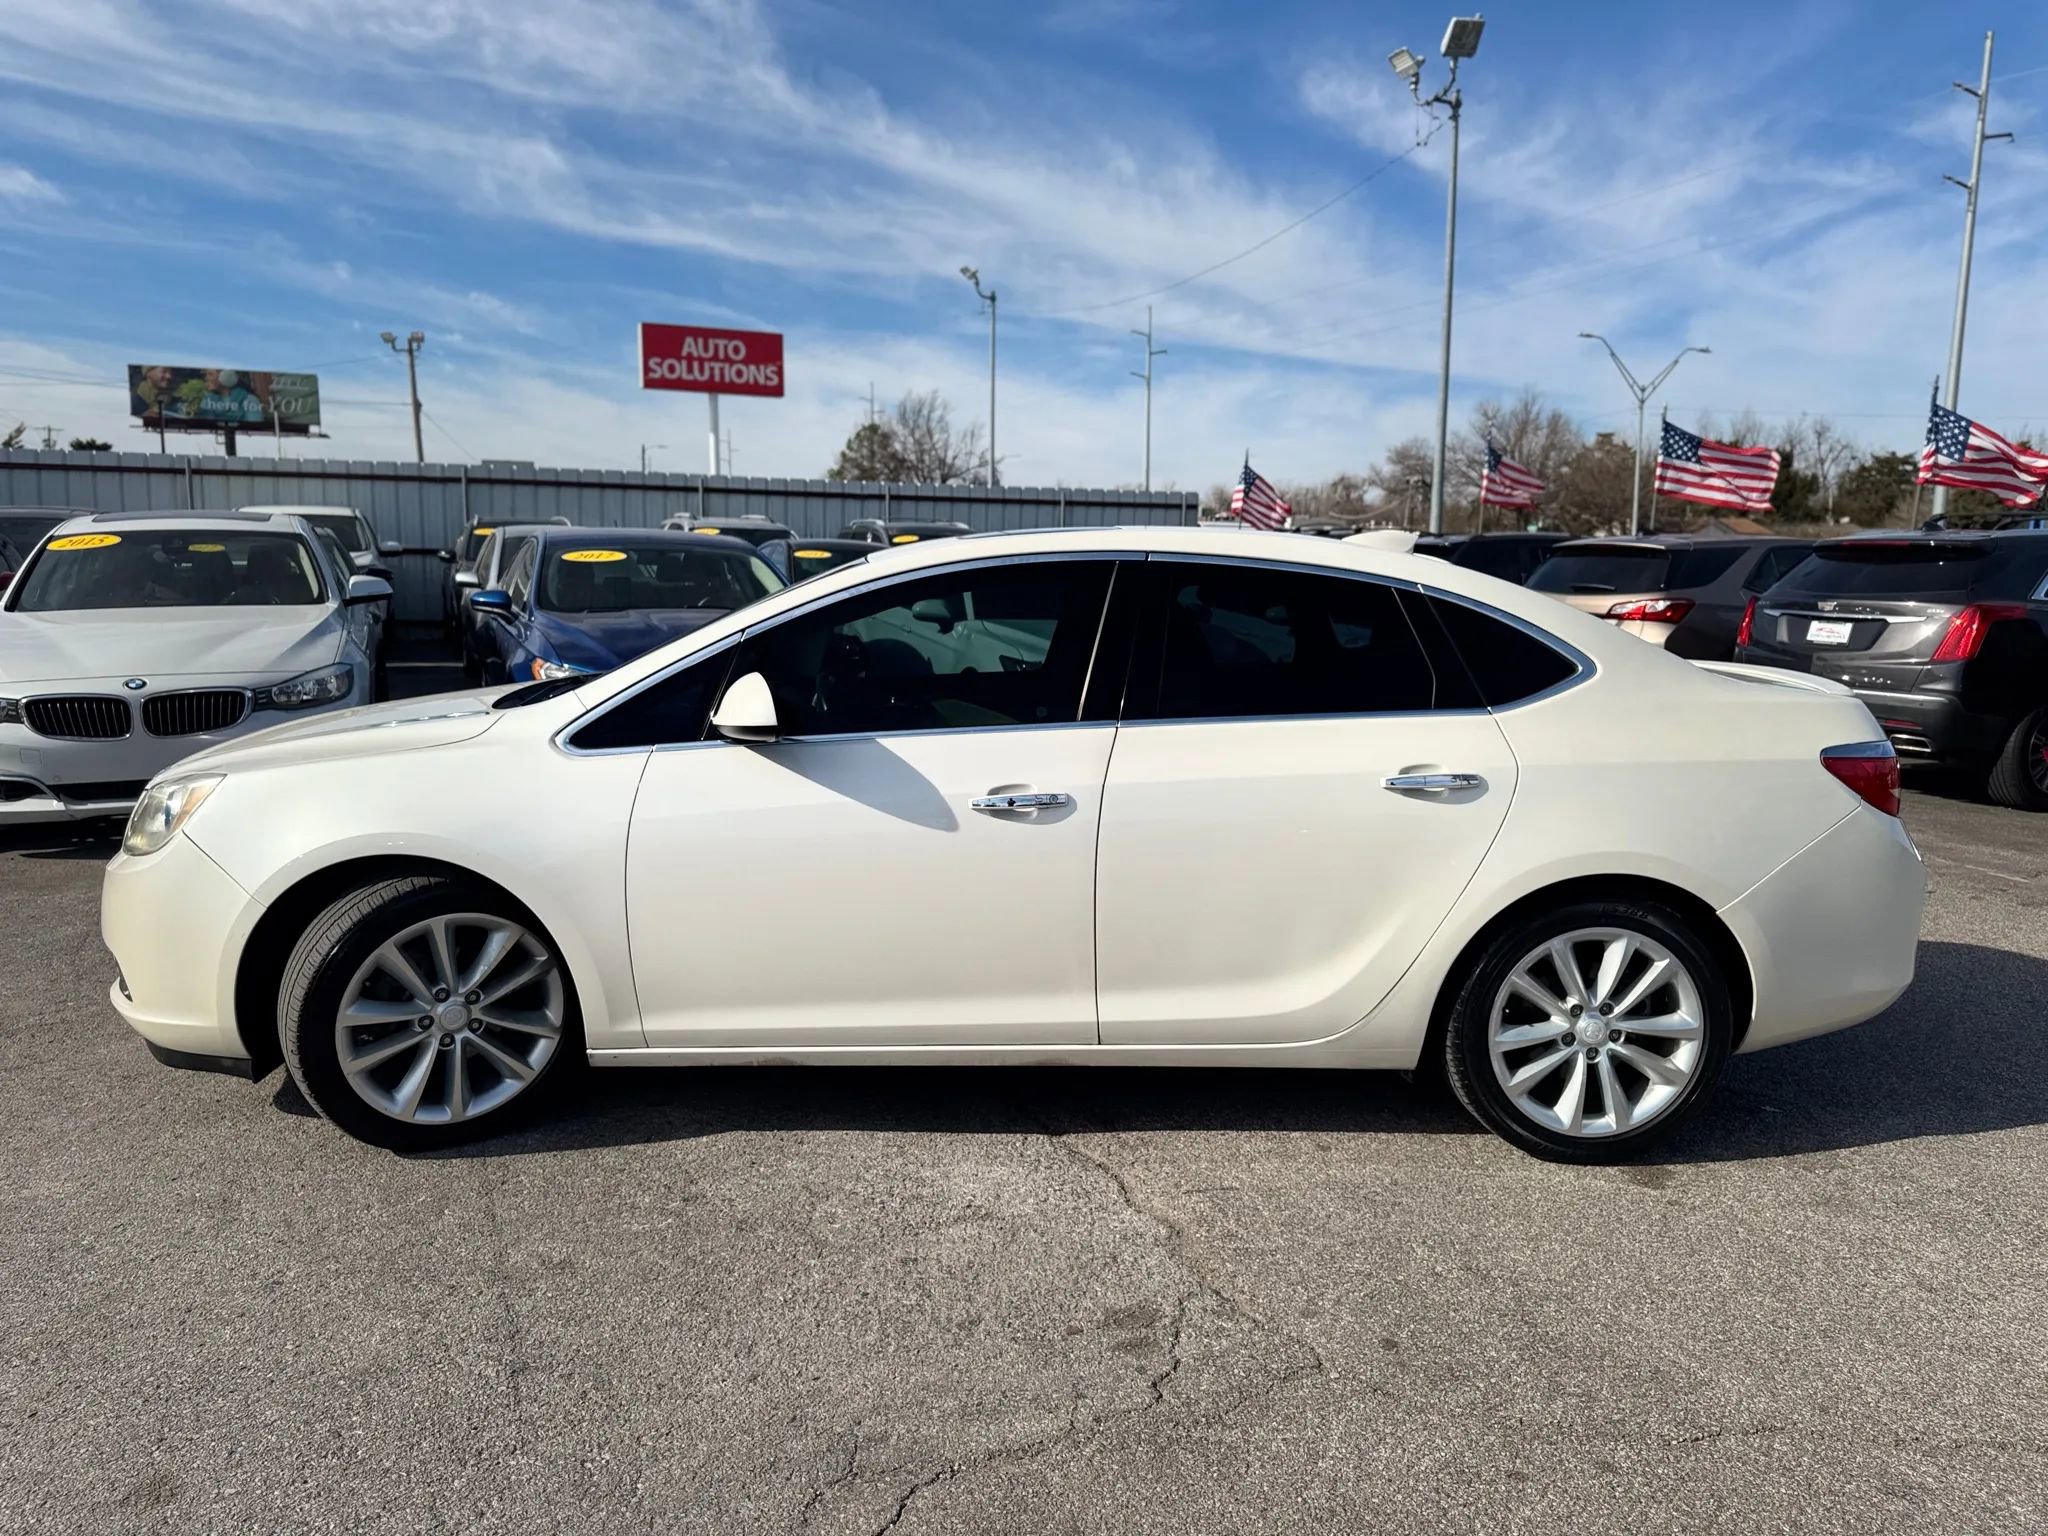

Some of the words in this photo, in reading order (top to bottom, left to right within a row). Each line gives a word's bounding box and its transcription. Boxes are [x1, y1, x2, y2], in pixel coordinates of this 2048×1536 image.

[681, 335, 747, 361] AUTO
[648, 356, 779, 387] SOLUTIONS
[267, 395, 313, 414] YOU
[58, 536, 107, 548] 2015
